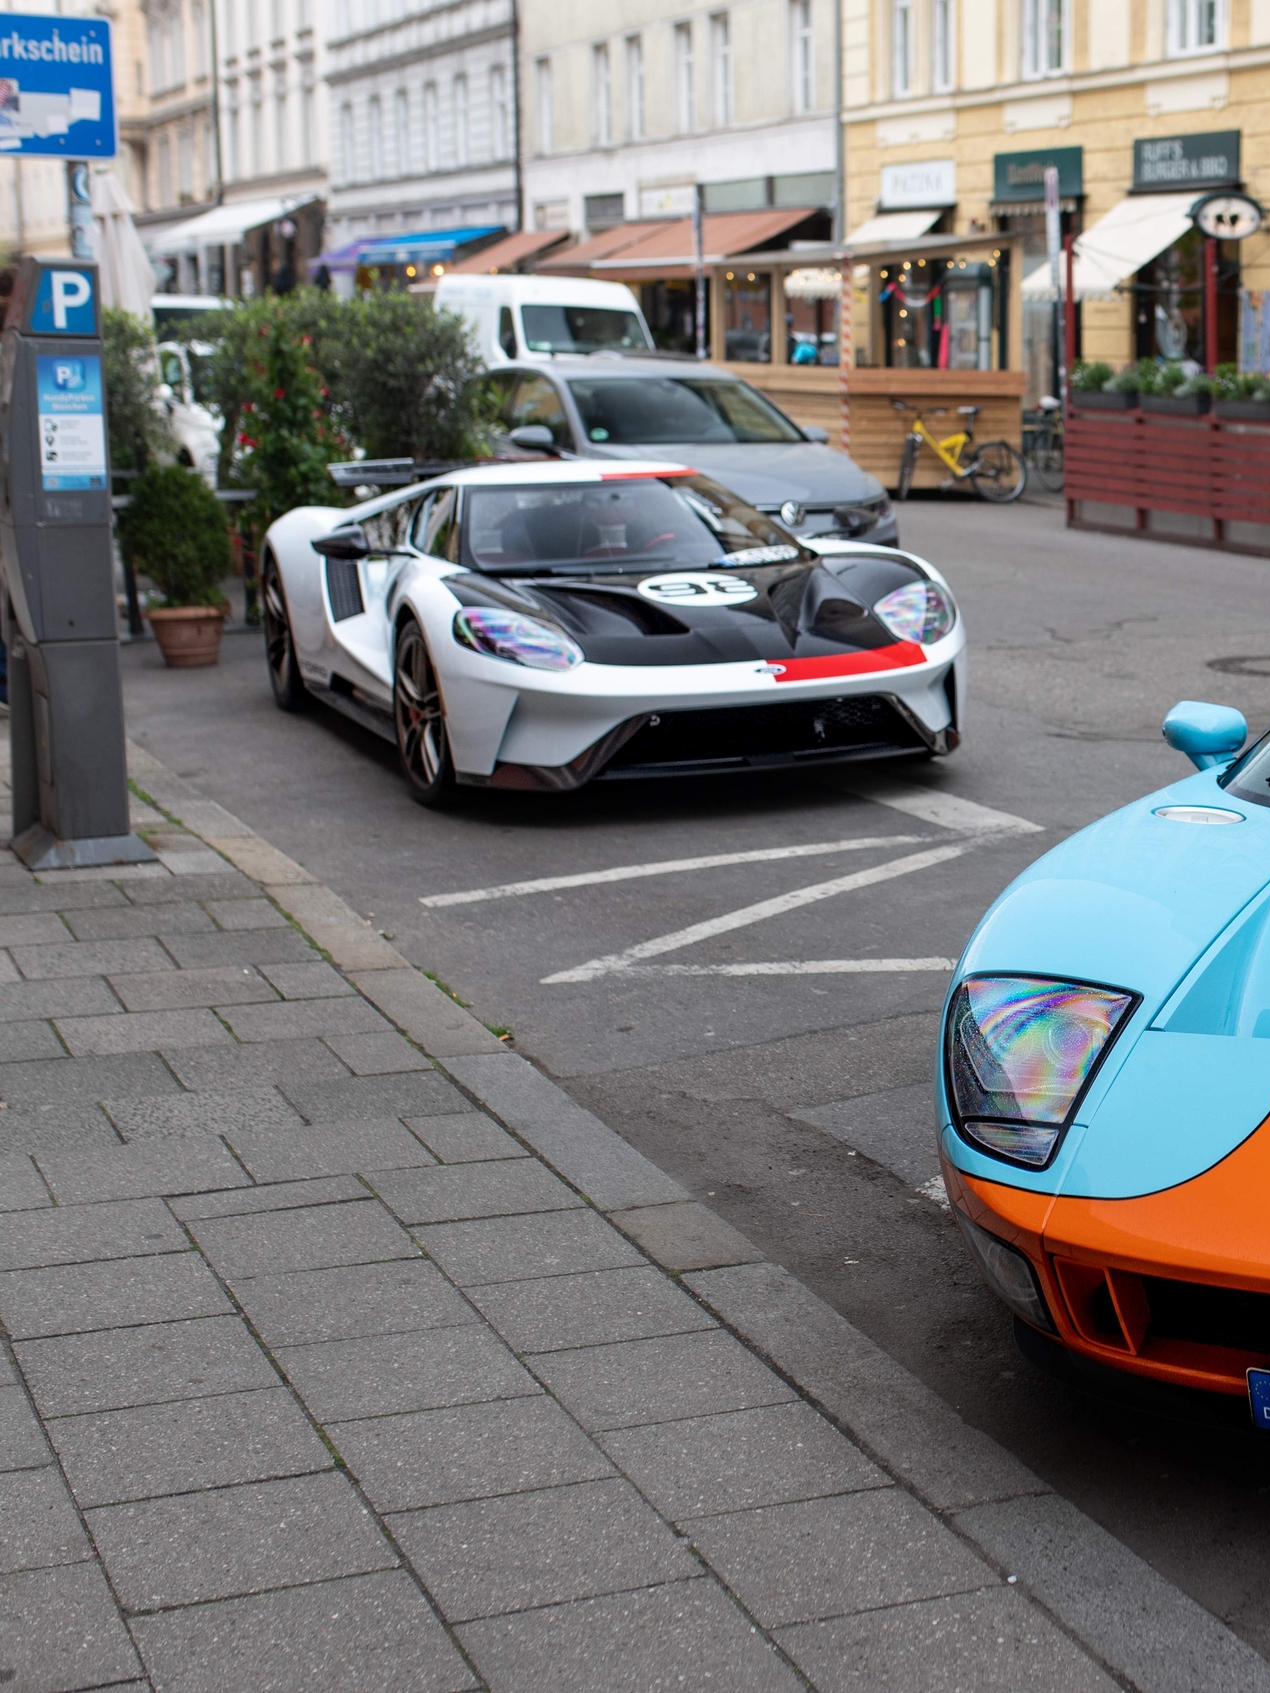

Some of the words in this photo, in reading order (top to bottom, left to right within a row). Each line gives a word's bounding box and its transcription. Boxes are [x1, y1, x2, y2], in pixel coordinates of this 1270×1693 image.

[0, 29, 103, 64] rkschein
[1142, 158, 1189, 181] BURGER
[51, 271, 91, 329] P
